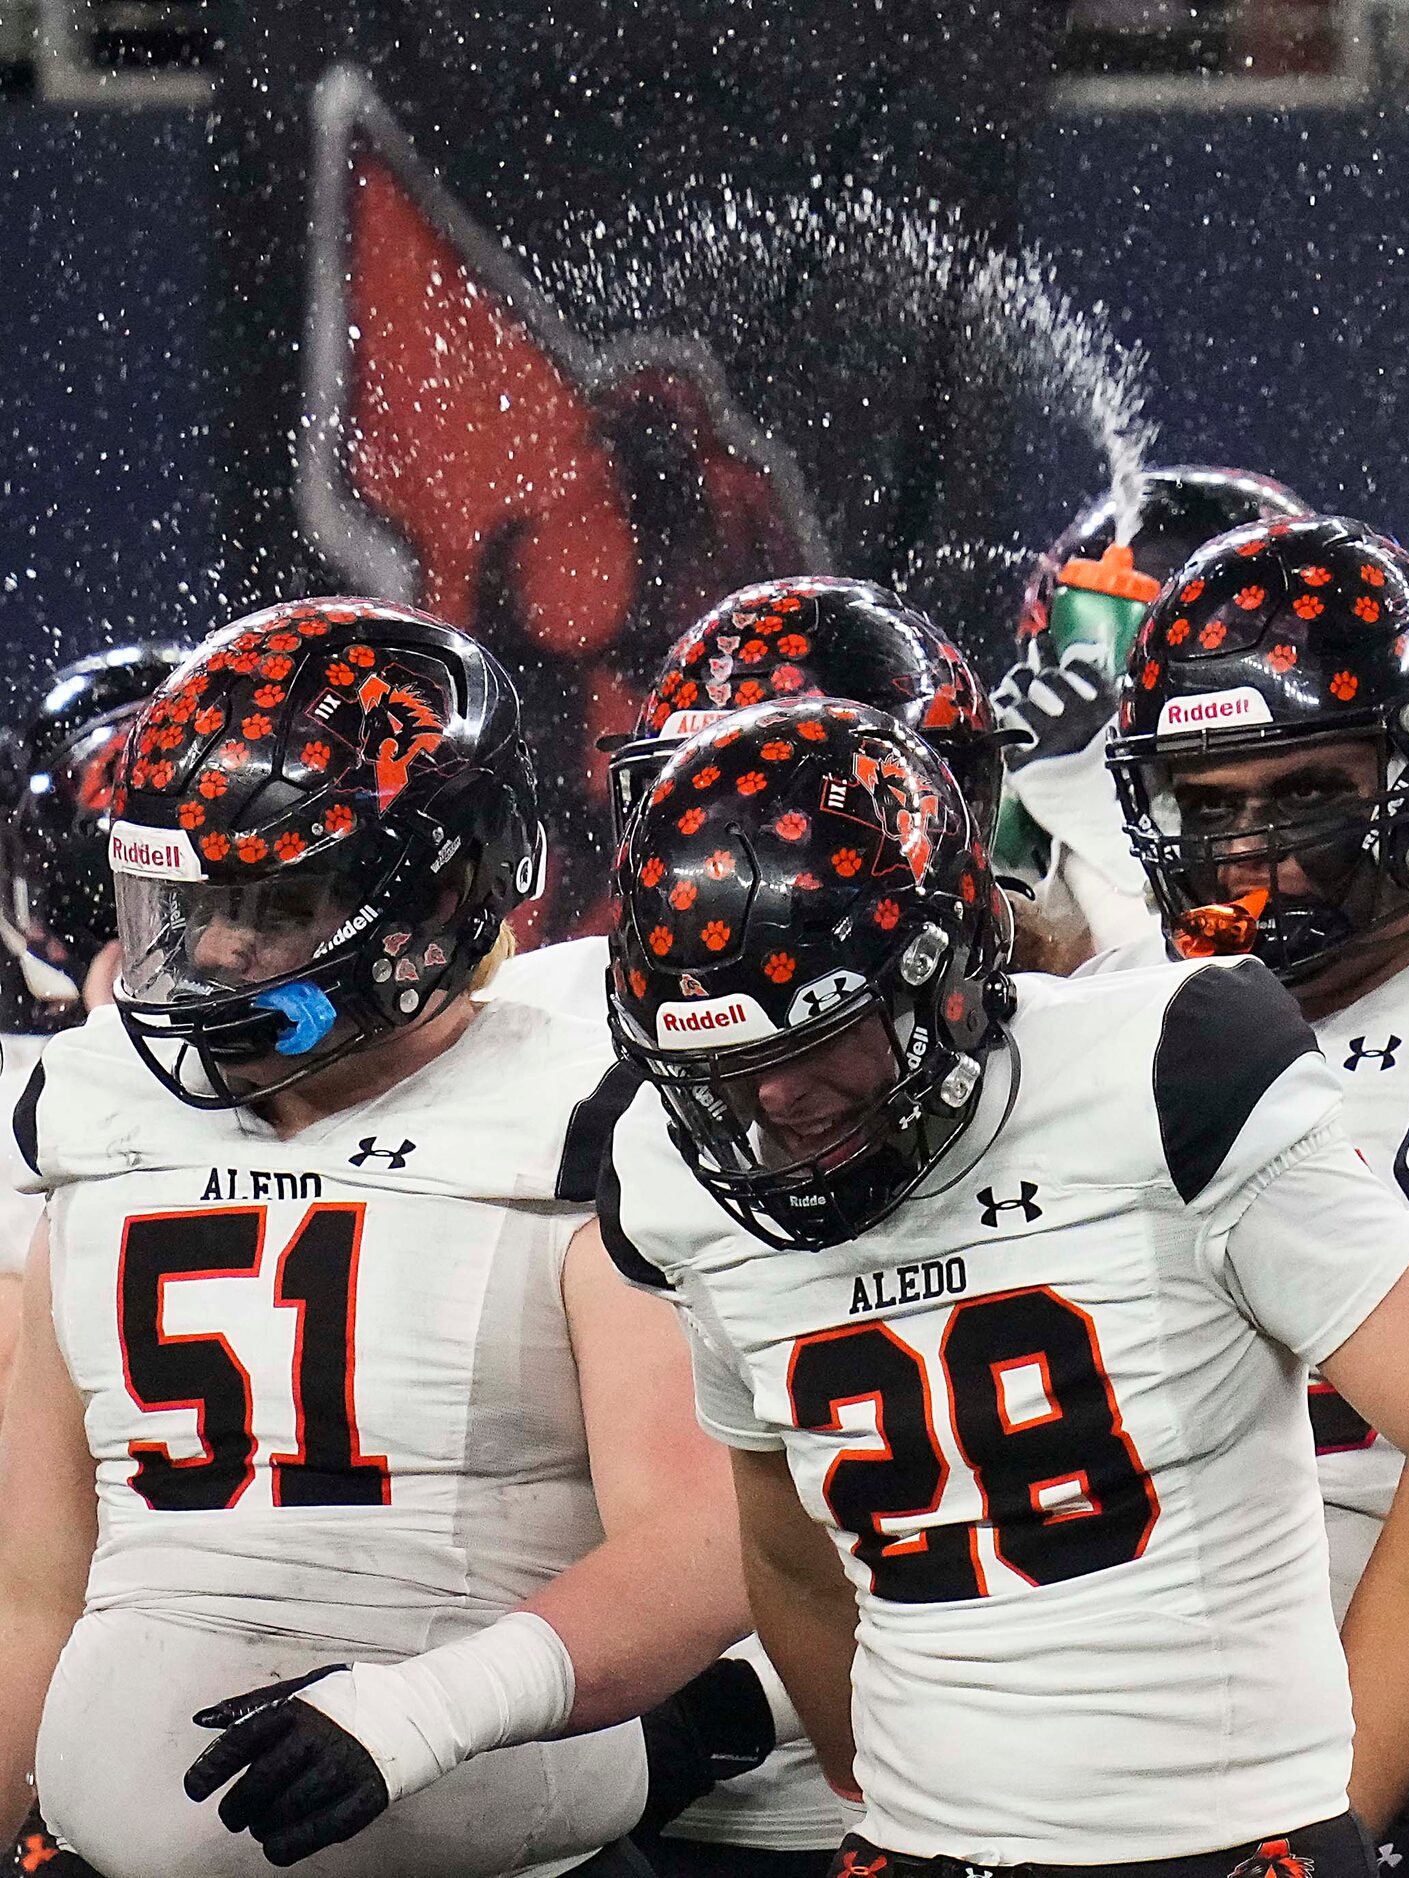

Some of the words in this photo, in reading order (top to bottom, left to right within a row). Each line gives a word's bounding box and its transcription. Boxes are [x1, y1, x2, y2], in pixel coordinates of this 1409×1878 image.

[1168, 699, 1249, 724] Riddell
[113, 836, 180, 868] Riddell
[663, 1003, 747, 1032] Riddell
[789, 1191, 835, 1207] Ridde
[849, 1256, 967, 1315] ALEDO
[116, 1202, 391, 1511] 51
[786, 1285, 1161, 1604] 28
